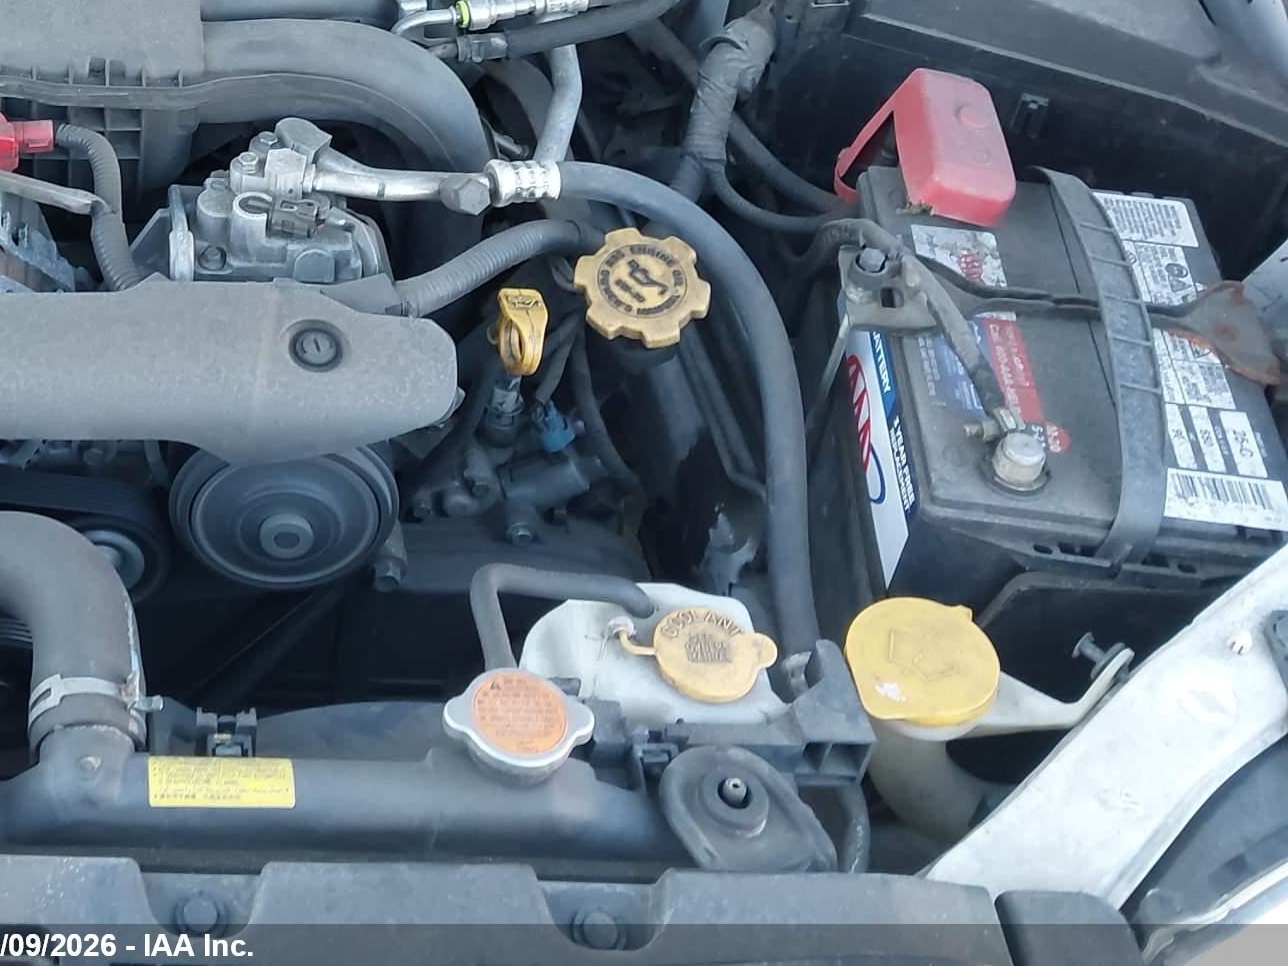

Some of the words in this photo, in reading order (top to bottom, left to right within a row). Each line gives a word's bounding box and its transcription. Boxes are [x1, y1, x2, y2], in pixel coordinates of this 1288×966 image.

[630, 245, 675, 267] ENGINE
[896, 425, 907, 466] YEAR
[902, 464, 916, 507] FREE
[661, 609, 744, 638] COOLANT
